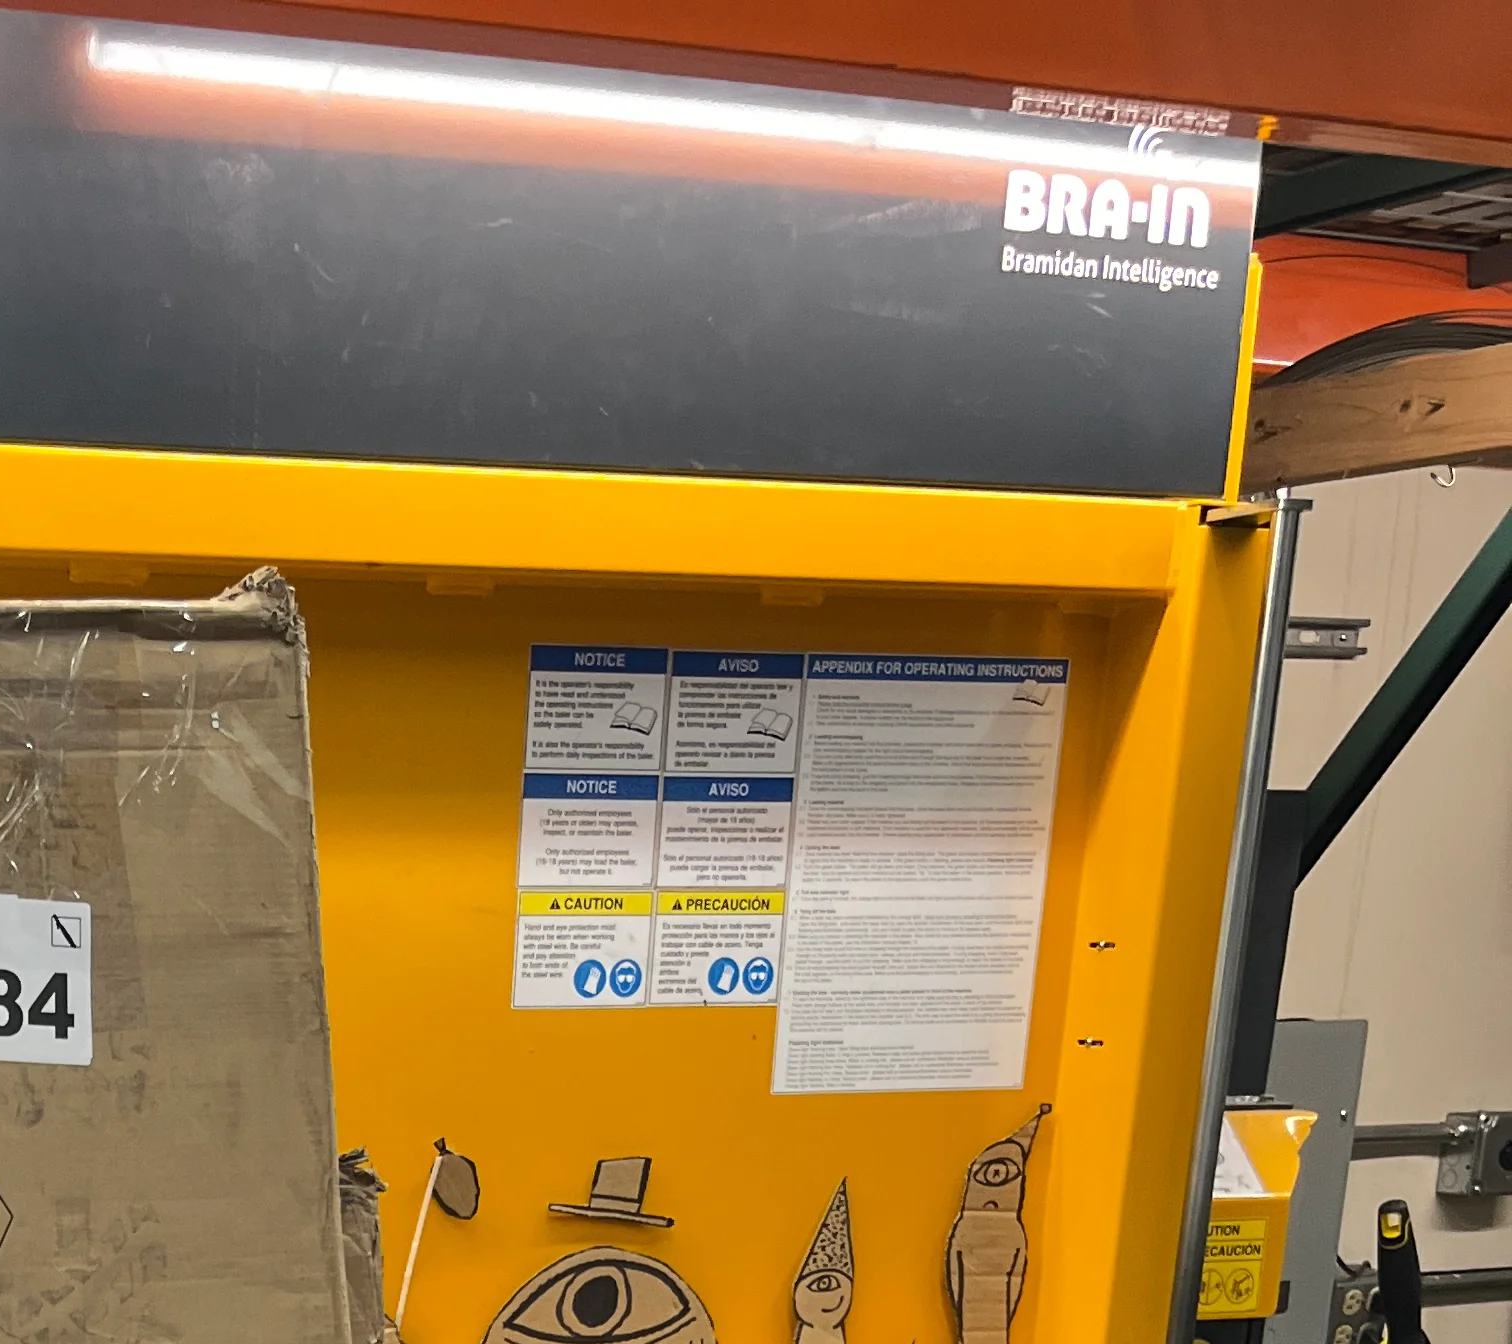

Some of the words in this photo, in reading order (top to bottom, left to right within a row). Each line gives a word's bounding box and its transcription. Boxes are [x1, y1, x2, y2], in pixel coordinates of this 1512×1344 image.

[1004, 169, 1211, 249] BRA-IN
[1001, 245, 1098, 279] Bramidan
[1102, 255, 1219, 292] Intelligence
[575, 652, 626, 667] NOTICE
[718, 659, 759, 672] AVISO
[812, 660, 873, 674] APPENDIX
[876, 662, 902, 675] FOR
[905, 662, 974, 677] OPERATING
[977, 663, 1063, 678] INSTRUCTIONS
[567, 780, 617, 793] NOTICE
[709, 783, 749, 796] AVISO
[564, 898, 624, 910] CAUTION
[686, 896, 770, 910] PRECAUCIÓN
[1207, 1225, 1240, 1236] UTION
[1205, 1243, 1260, 1257] ECAUCIÓN
